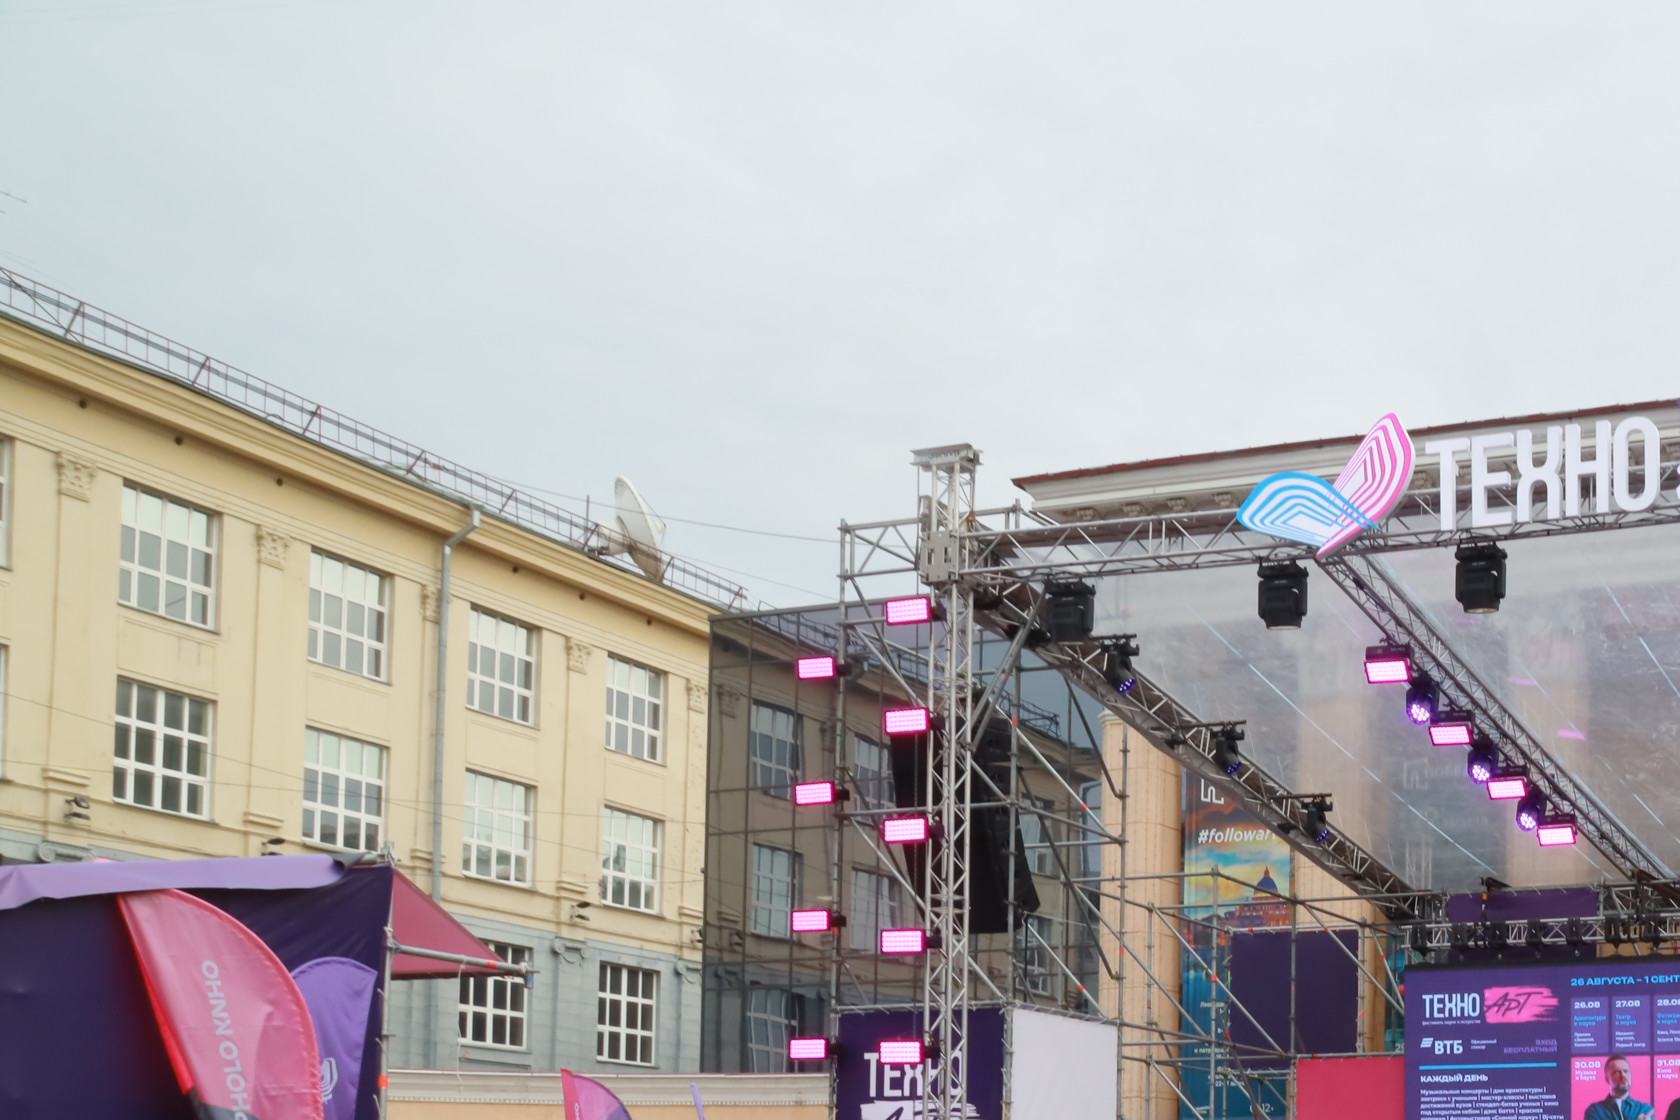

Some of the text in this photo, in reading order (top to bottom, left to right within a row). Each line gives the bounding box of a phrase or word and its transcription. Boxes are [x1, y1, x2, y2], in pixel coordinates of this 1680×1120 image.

[1426, 416, 1661, 531] ТЕХНО
[1571, 978, 1585, 987] 26
[1586, 976, 1635, 986] АВГУСТА
[1644, 976, 1650, 984] 1
[1422, 993, 1480, 1018] ТЕХНО
[1574, 1001, 1601, 1009] 26.08
[1615, 1000, 1641, 1008] 27.08
[1434, 1040, 1463, 1055] ВТБ
[1536, 1039, 1557, 1047] ВХОД
[1504, 1046, 1557, 1054] БЕСПЛАТНЫЙ
[1574, 1060, 1601, 1069] 30.08
[1420, 1073, 1489, 1083] КАЖДЫЙ ДЕНЬ
